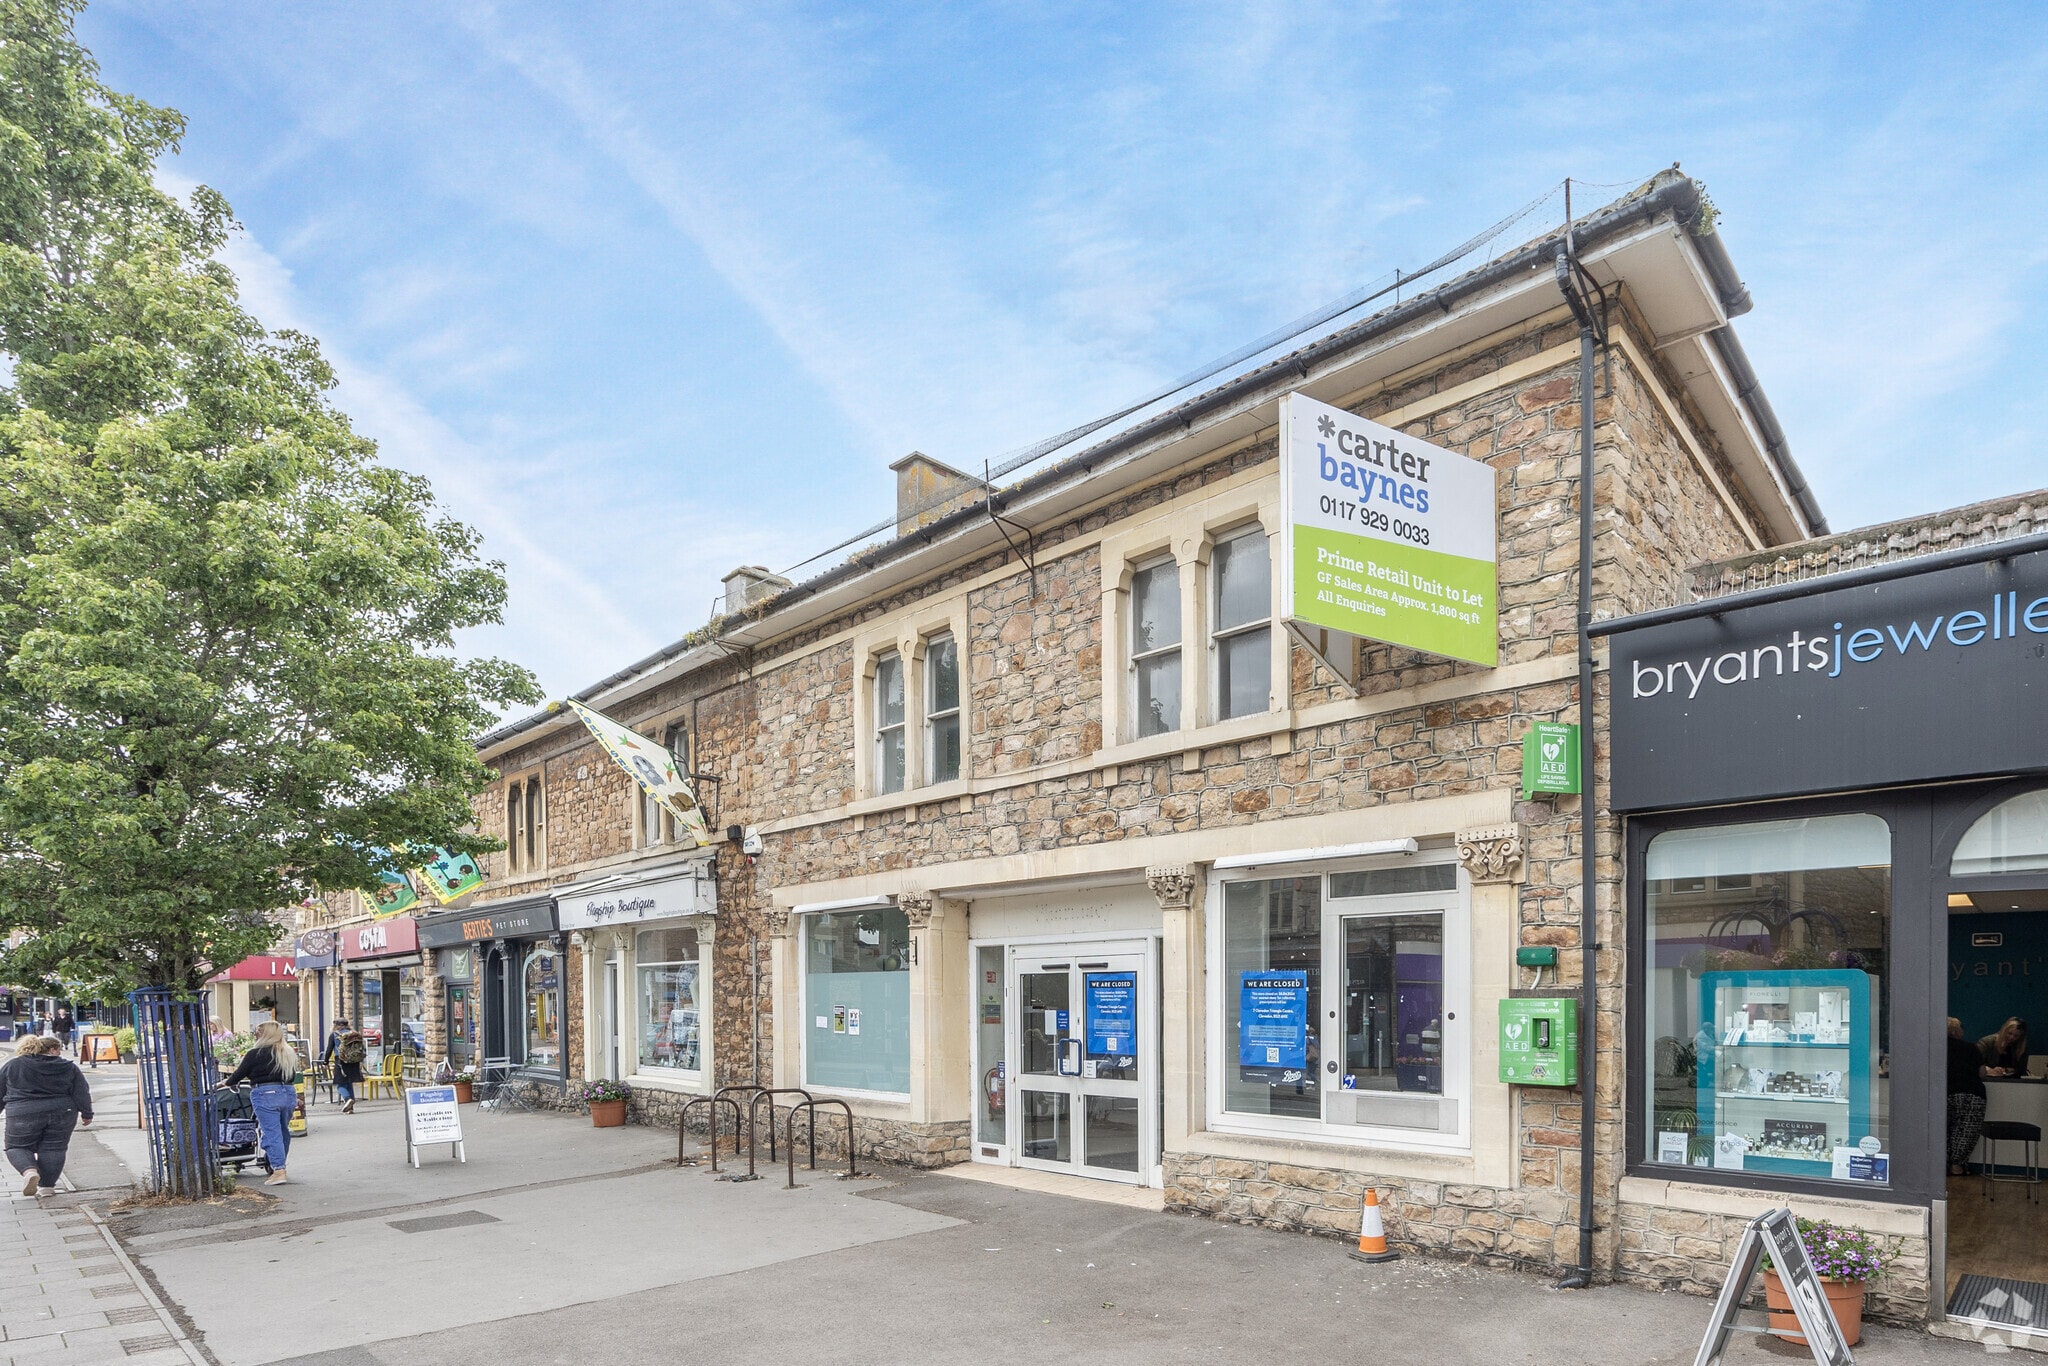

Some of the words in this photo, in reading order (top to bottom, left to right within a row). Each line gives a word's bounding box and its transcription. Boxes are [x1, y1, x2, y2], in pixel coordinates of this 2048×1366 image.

[1338, 429, 1429, 483] carter
[1317, 443, 1429, 513] baynes
[1320, 495, 1356, 521] 0117
[1361, 509, 1388, 532] 929
[1393, 519, 1429, 546] 0033
[1317, 547, 1363, 573] Prime
[1367, 561, 1409, 587] Retail
[1412, 575, 1442, 597] Unit
[1446, 586, 1459, 601] to
[1462, 589, 1483, 607] Let
[1317, 571, 1331, 583] GF
[1334, 575, 1361, 593] Sales
[1364, 584, 1389, 600] Area
[1391, 591, 1429, 613] Approx.
[1431, 603, 1456, 619] 1,800
[1459, 612, 1469, 624] sq
[1471, 611, 1480, 624] ft
[1317, 589, 1333, 602] All
[1336, 595, 1386, 617] Enquiries
[1543, 764, 1564, 772] AED
[510, 919, 529, 927] STORE
[587, 901, 615, 922] Flagship
[618, 898, 655, 917] Boutique
[308, 931, 329, 940] COSTA
[306, 945, 333, 955] COFFEE
[1282, 1070, 1302, 1082] Boots
